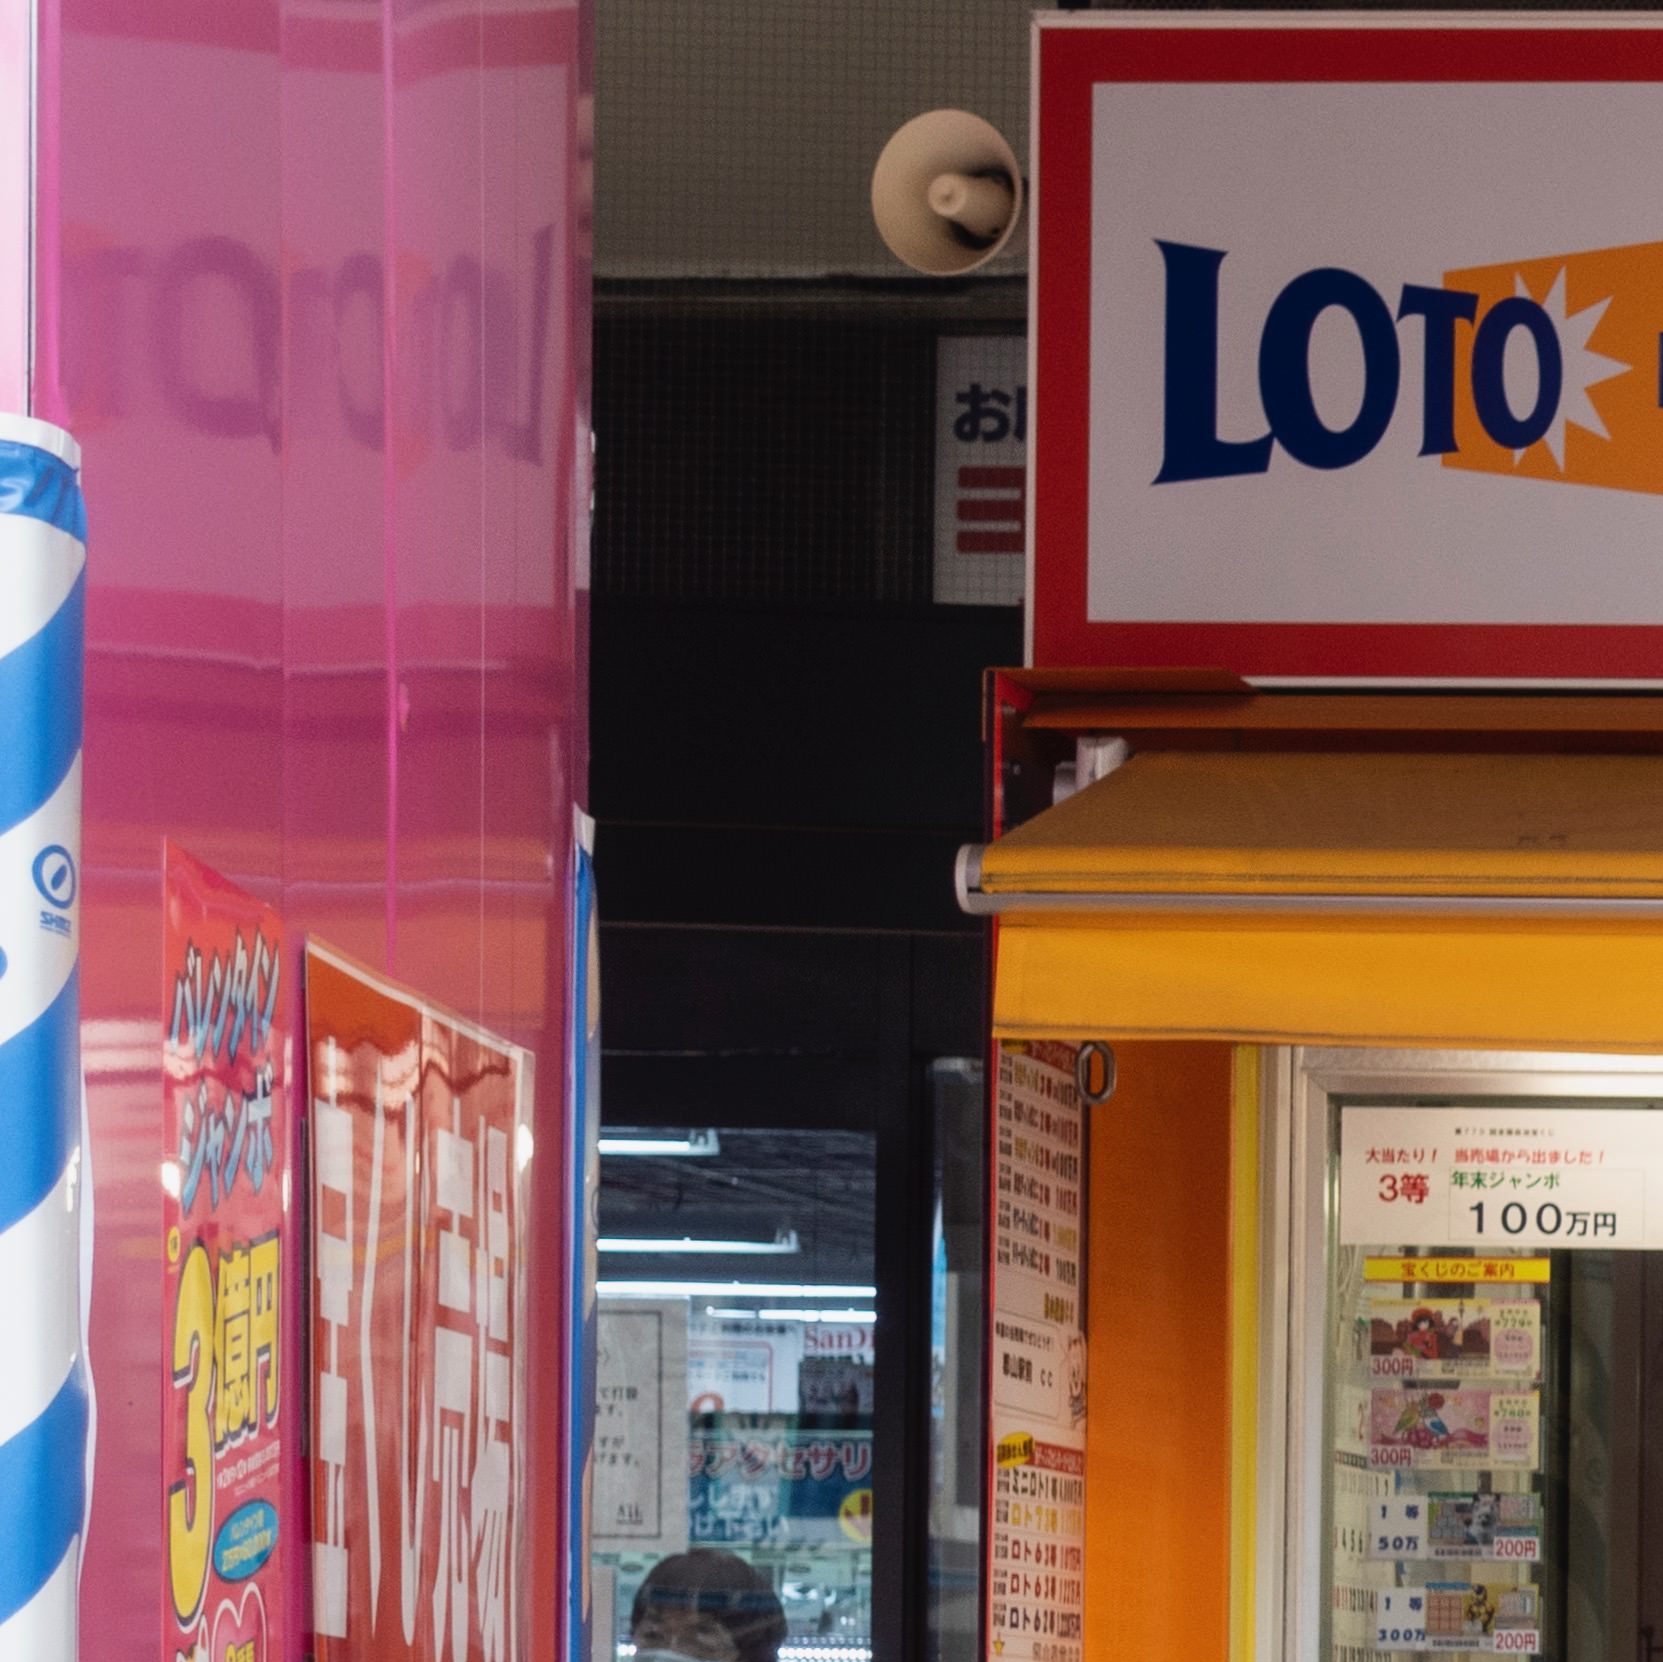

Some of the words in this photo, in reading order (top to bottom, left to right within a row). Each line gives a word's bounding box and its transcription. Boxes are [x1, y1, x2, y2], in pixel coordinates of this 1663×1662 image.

[1151, 239, 1562, 485] LOTO
[1378, 1173, 1430, 1205] 3等
[1450, 1169, 1561, 1191] 年末ジャンボ
[1468, 1201, 1618, 1237] 100万円
[1401, 1261, 1516, 1280] 宝くじのご案内
[1372, 1357, 1414, 1376] 300円
[1371, 1447, 1412, 1466] 300円
[1495, 1539, 1537, 1559] 200円
[1495, 1632, 1537, 1651] 200円
